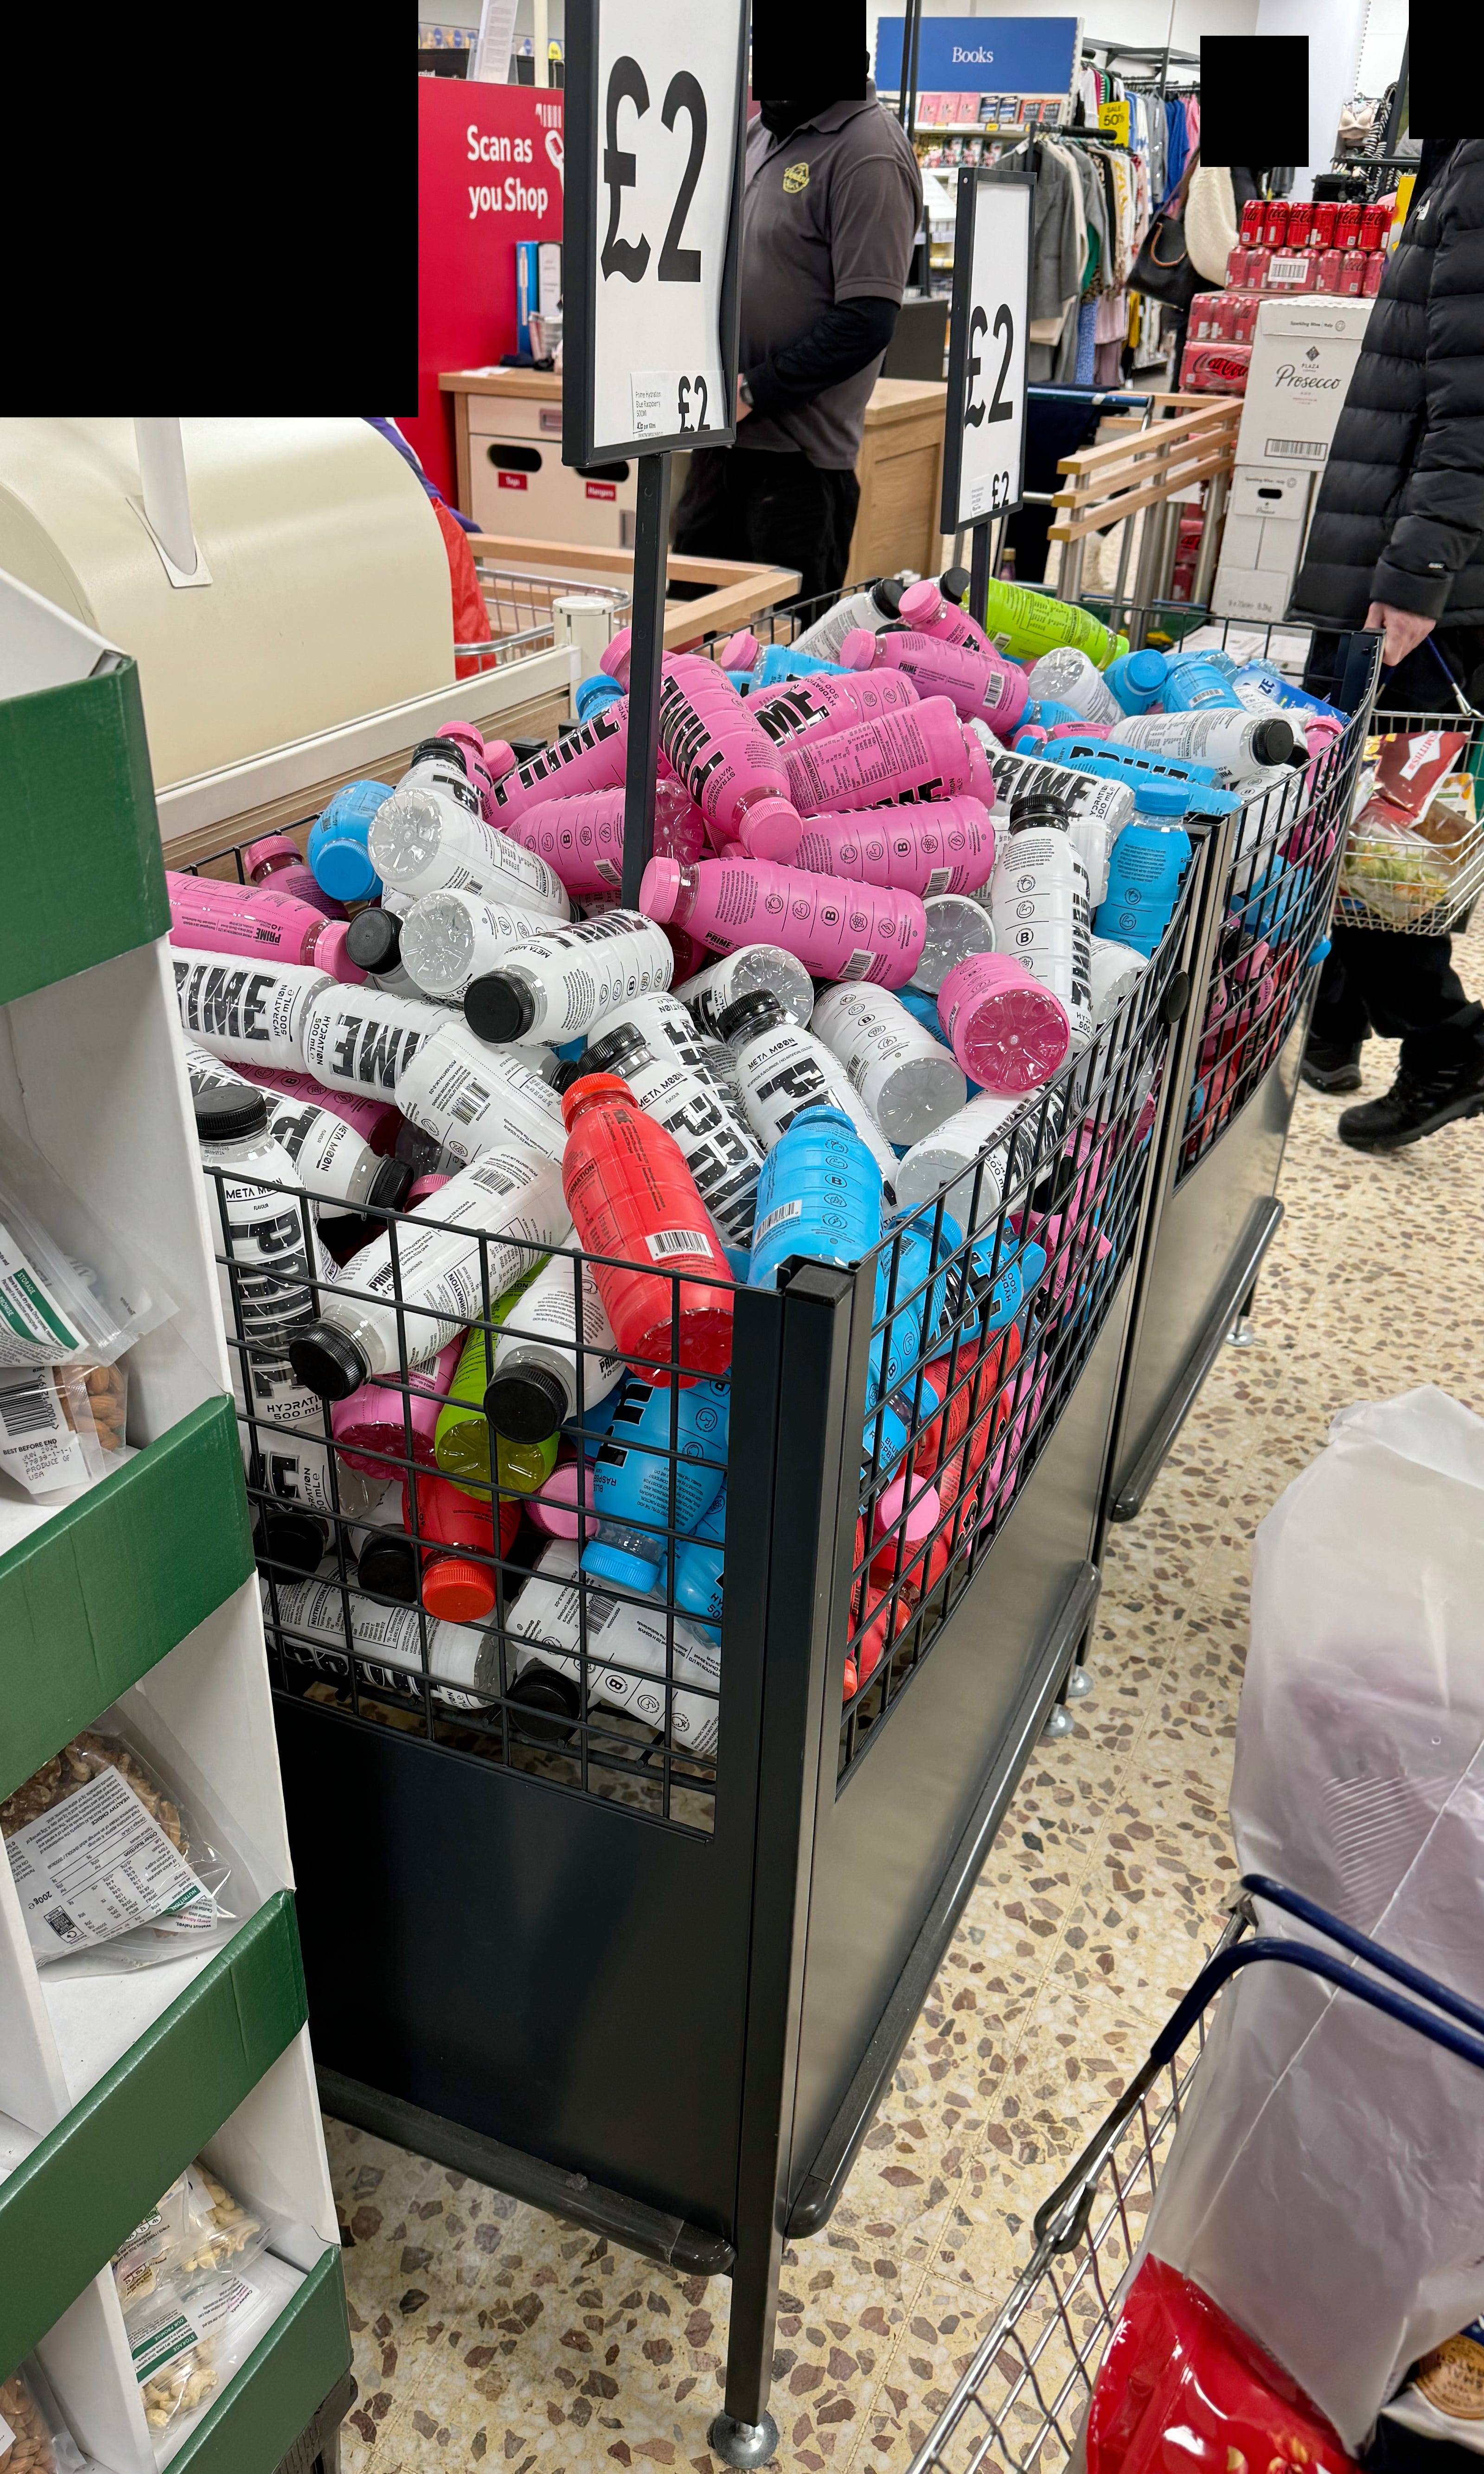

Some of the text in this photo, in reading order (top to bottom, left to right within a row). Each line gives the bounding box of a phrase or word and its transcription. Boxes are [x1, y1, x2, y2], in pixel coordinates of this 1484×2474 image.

[952, 47, 993, 64] Books
[467, 125, 533, 163] Scan as
[601, 56, 708, 283] £2
[468, 177, 548, 219] you Shop
[964, 303, 1014, 430] £2
[1275, 364, 1342, 389] Prosecco
[678, 375, 710, 434] £2
[992, 471, 1009, 510] £2
[898, 662, 917, 675] PRIME
[825, 684, 839, 699] 500
[1411, 732, 1438, 766] SMITHS
[699, 766, 732, 818] WATERMELON
[703, 769, 735, 820] STRAWBERRY
[808, 768, 824, 800] NUTRITION
[1089, 785, 1107, 815] YDRATIO
[255, 927, 281, 943] PRIME
[705, 930, 734, 951] PRIME
[172, 961, 277, 1042] IME
[277, 1015, 290, 1035] 500
[312, 1018, 321, 1036] 500
[747, 1053, 769, 1070] META
[635, 1088, 661, 1107] META
[665, 1092, 680, 1104] FLAVOUR
[317, 1129, 326, 1143] FLAVOUR
[333, 1124, 349, 1140] META
[225, 1178, 283, 1201] META MN
[16, 1272, 37, 1295] STORAGE
[448, 1272, 472, 1318] FORMATION
[274, 1409, 301, 1420] 500
[18, 1442, 43, 1452] BEFORE
[25, 1458, 58, 1475] PRODUCE
[28, 1471, 45, 1481] USA
[308, 1589, 329, 1625] NUTRITION
[91, 1796, 130, 1826] HEALTHY CHOICE
[122, 1831, 158, 1857] Other Nutrition
[33, 1891, 52, 1905] 200g
[153, 2318, 185, 2341] OUR PROMISE
[171, 2334, 195, 2352] STORAGE
